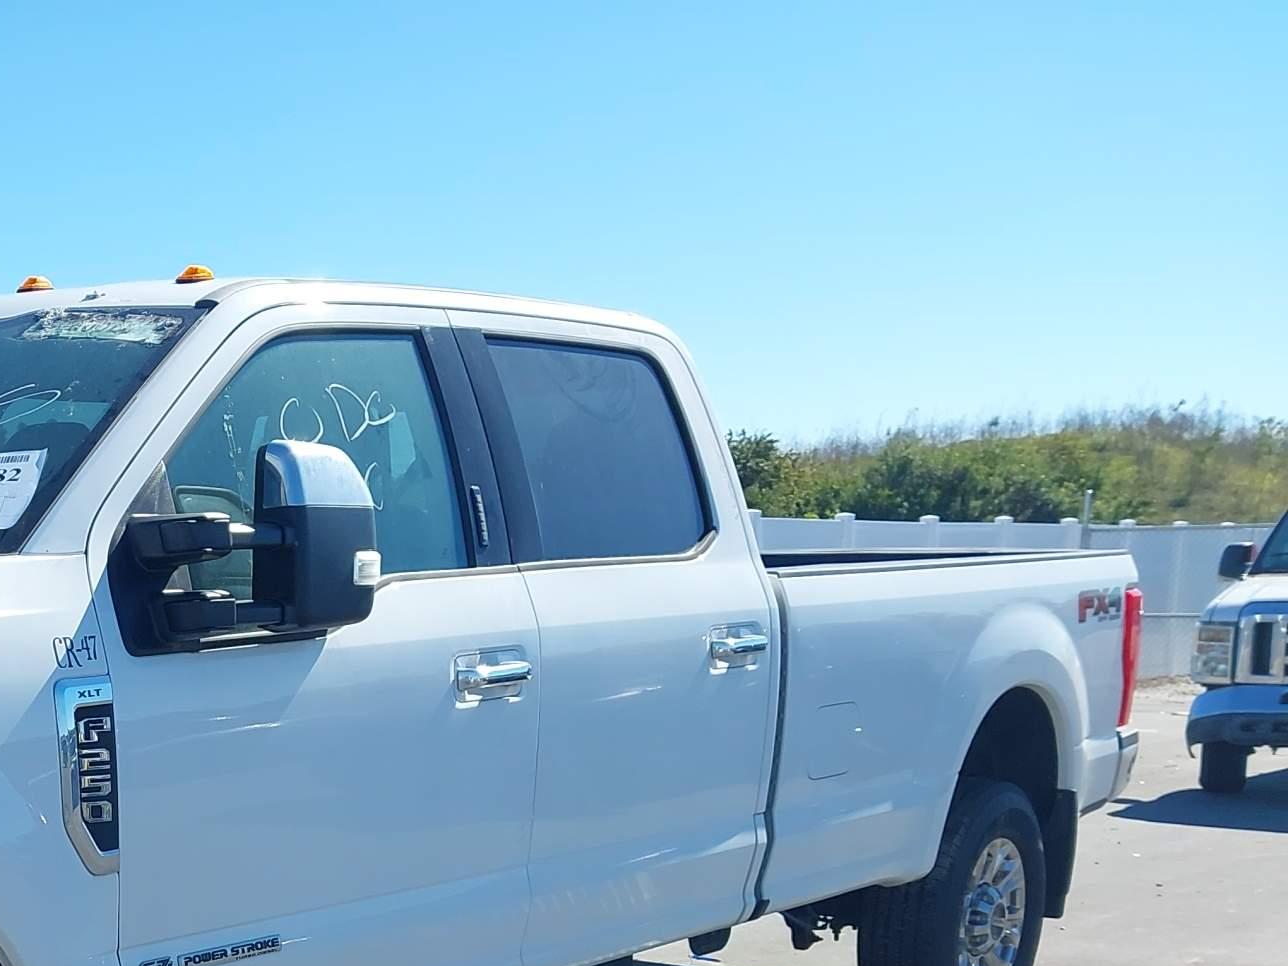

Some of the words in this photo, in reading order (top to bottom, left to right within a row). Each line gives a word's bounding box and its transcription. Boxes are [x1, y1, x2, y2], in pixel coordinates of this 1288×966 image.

[1078, 587, 1122, 624] FX4
[52, 635, 98, 669] CR-47
[77, 688, 103, 699] XLT
[184, 950, 229, 966] POWER
[230, 937, 280, 956] STROKE
